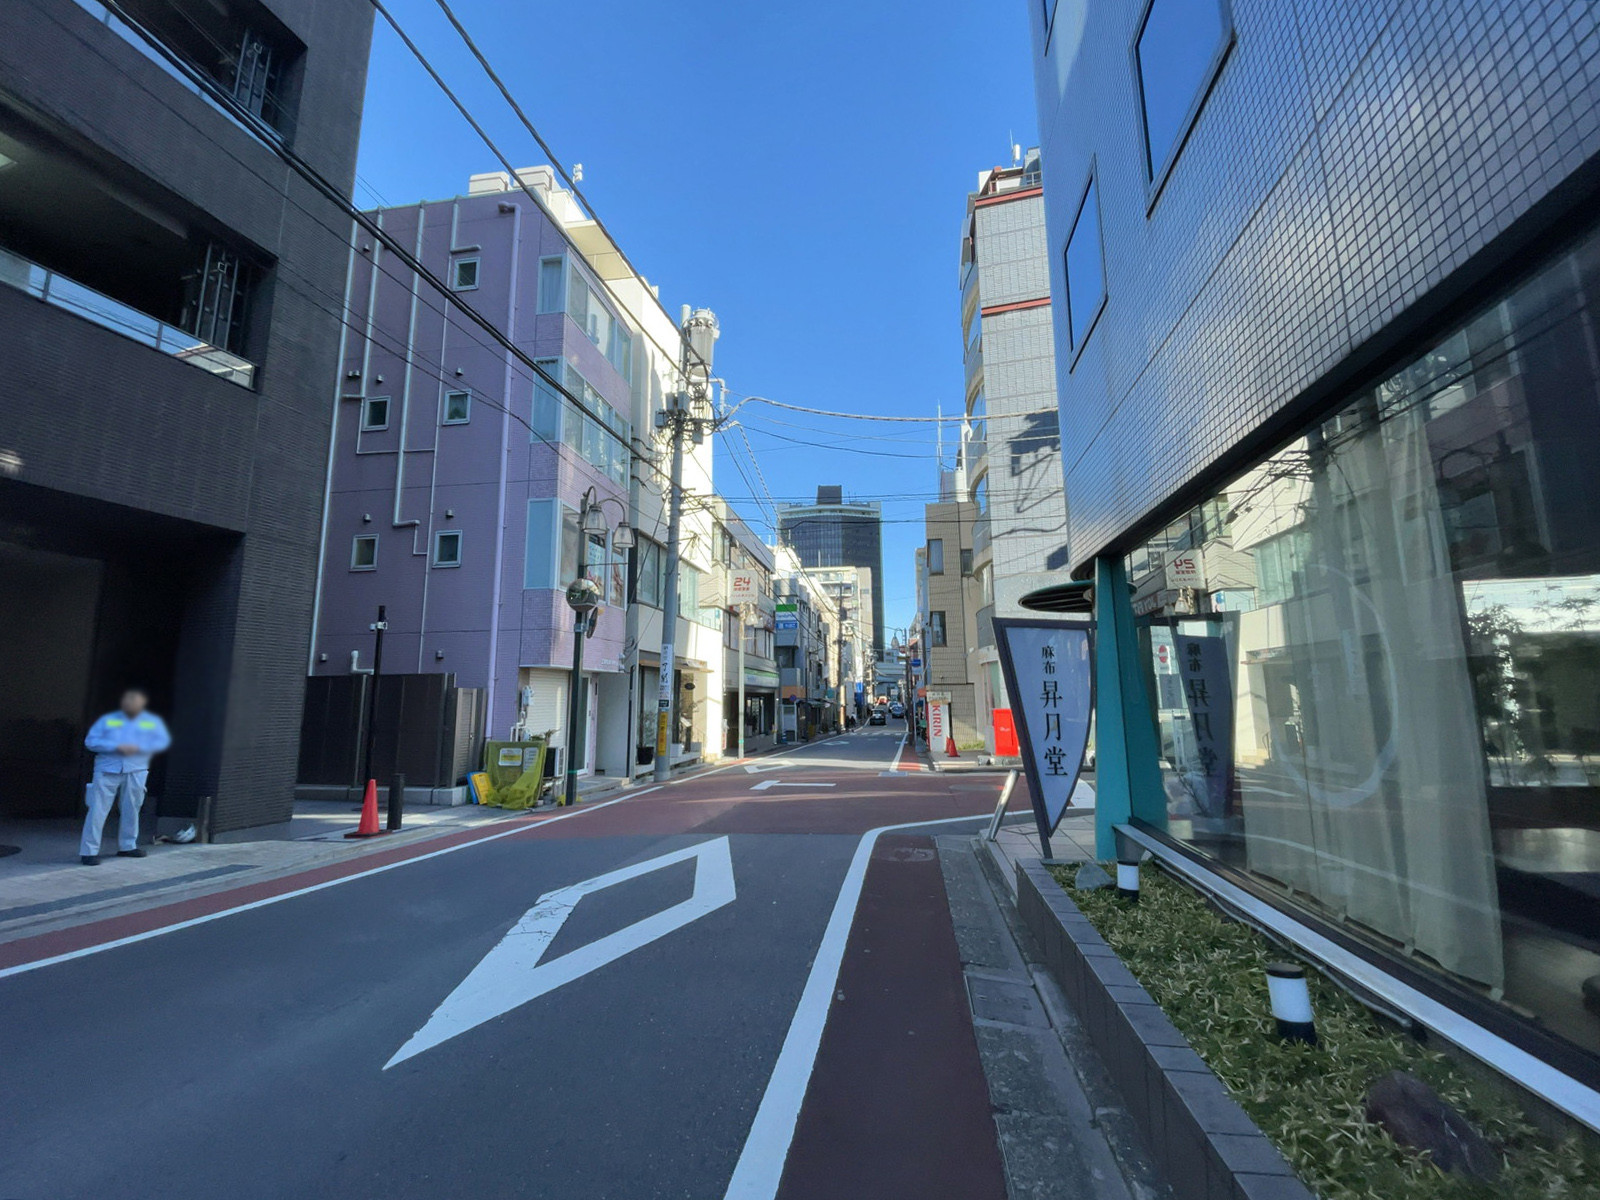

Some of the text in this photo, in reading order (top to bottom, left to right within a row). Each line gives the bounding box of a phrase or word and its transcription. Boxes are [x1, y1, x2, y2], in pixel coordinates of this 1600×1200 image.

[733, 577, 751, 586] 24
[932, 705, 942, 737] KIRIN
[1040, 645, 1068, 776] 麻布昇月堂
